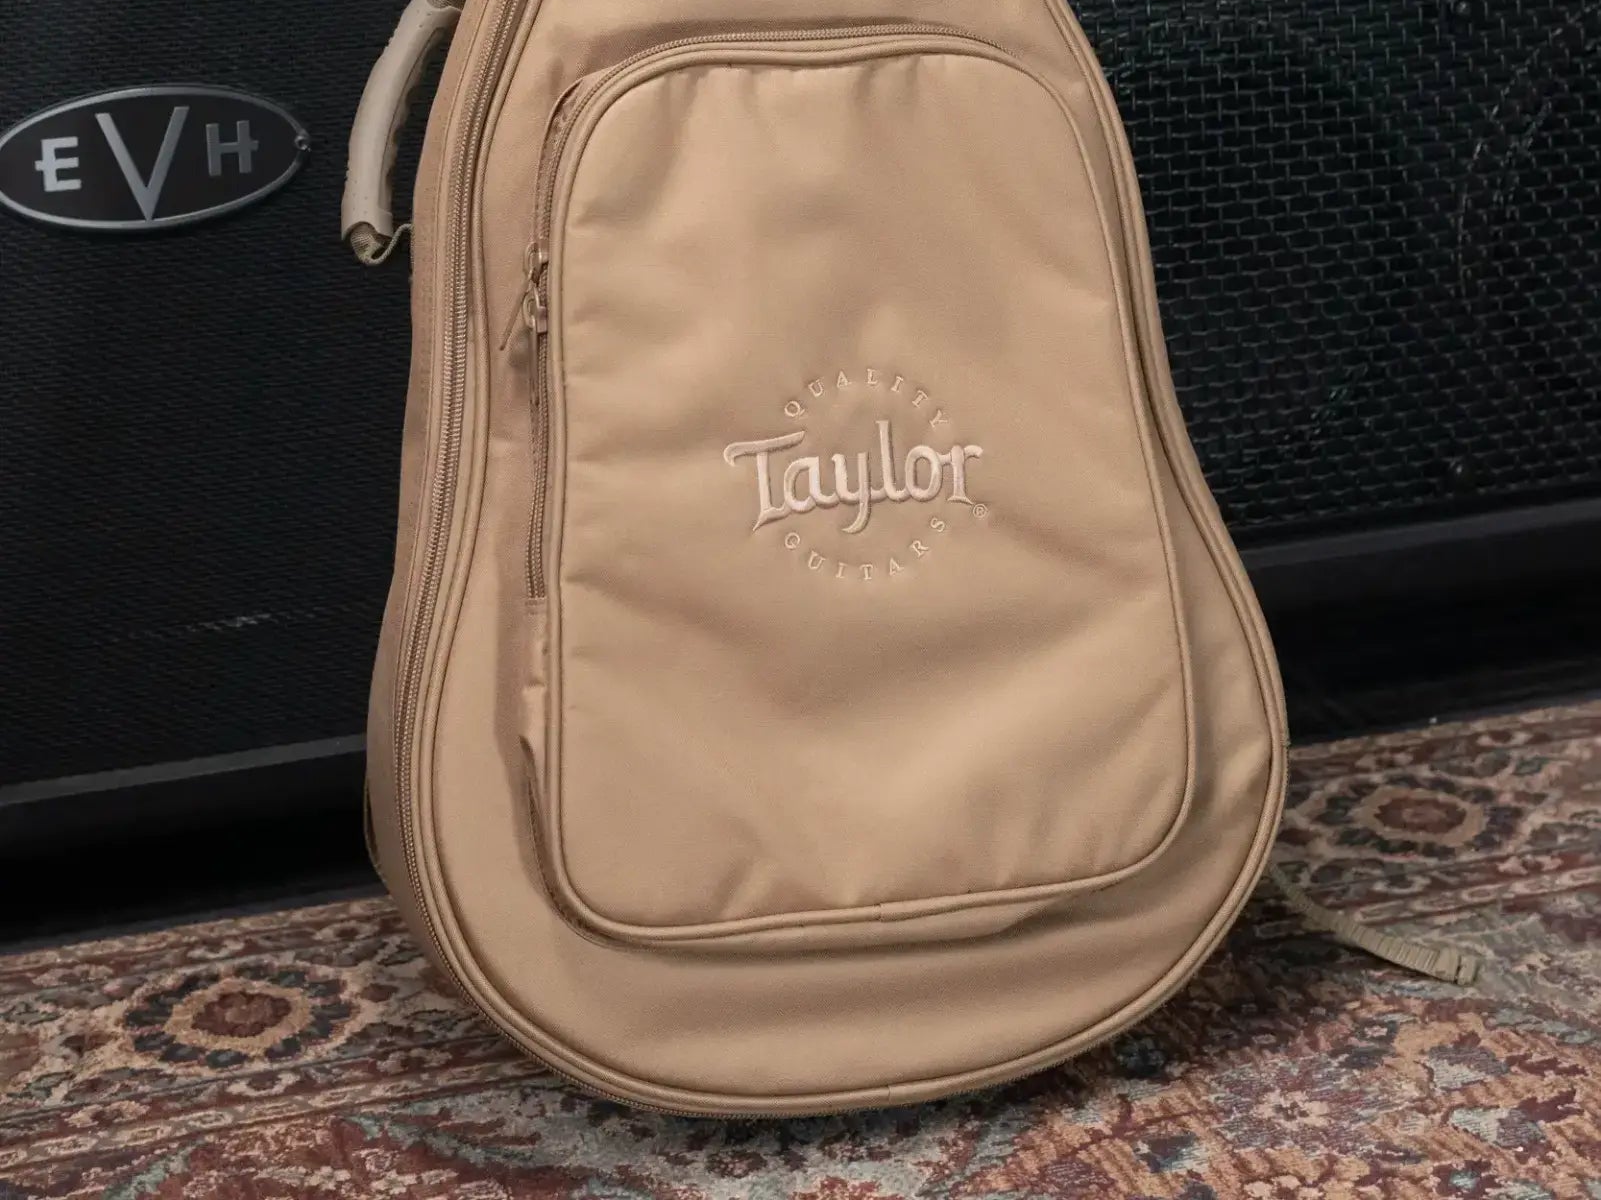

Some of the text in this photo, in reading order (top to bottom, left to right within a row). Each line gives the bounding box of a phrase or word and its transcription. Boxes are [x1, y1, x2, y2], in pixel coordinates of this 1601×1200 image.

[34, 106, 259, 223] EVH
[784, 367, 948, 429] QUALITY
[723, 420, 983, 534] Taylor
[784, 516, 946, 581] GUITARS
